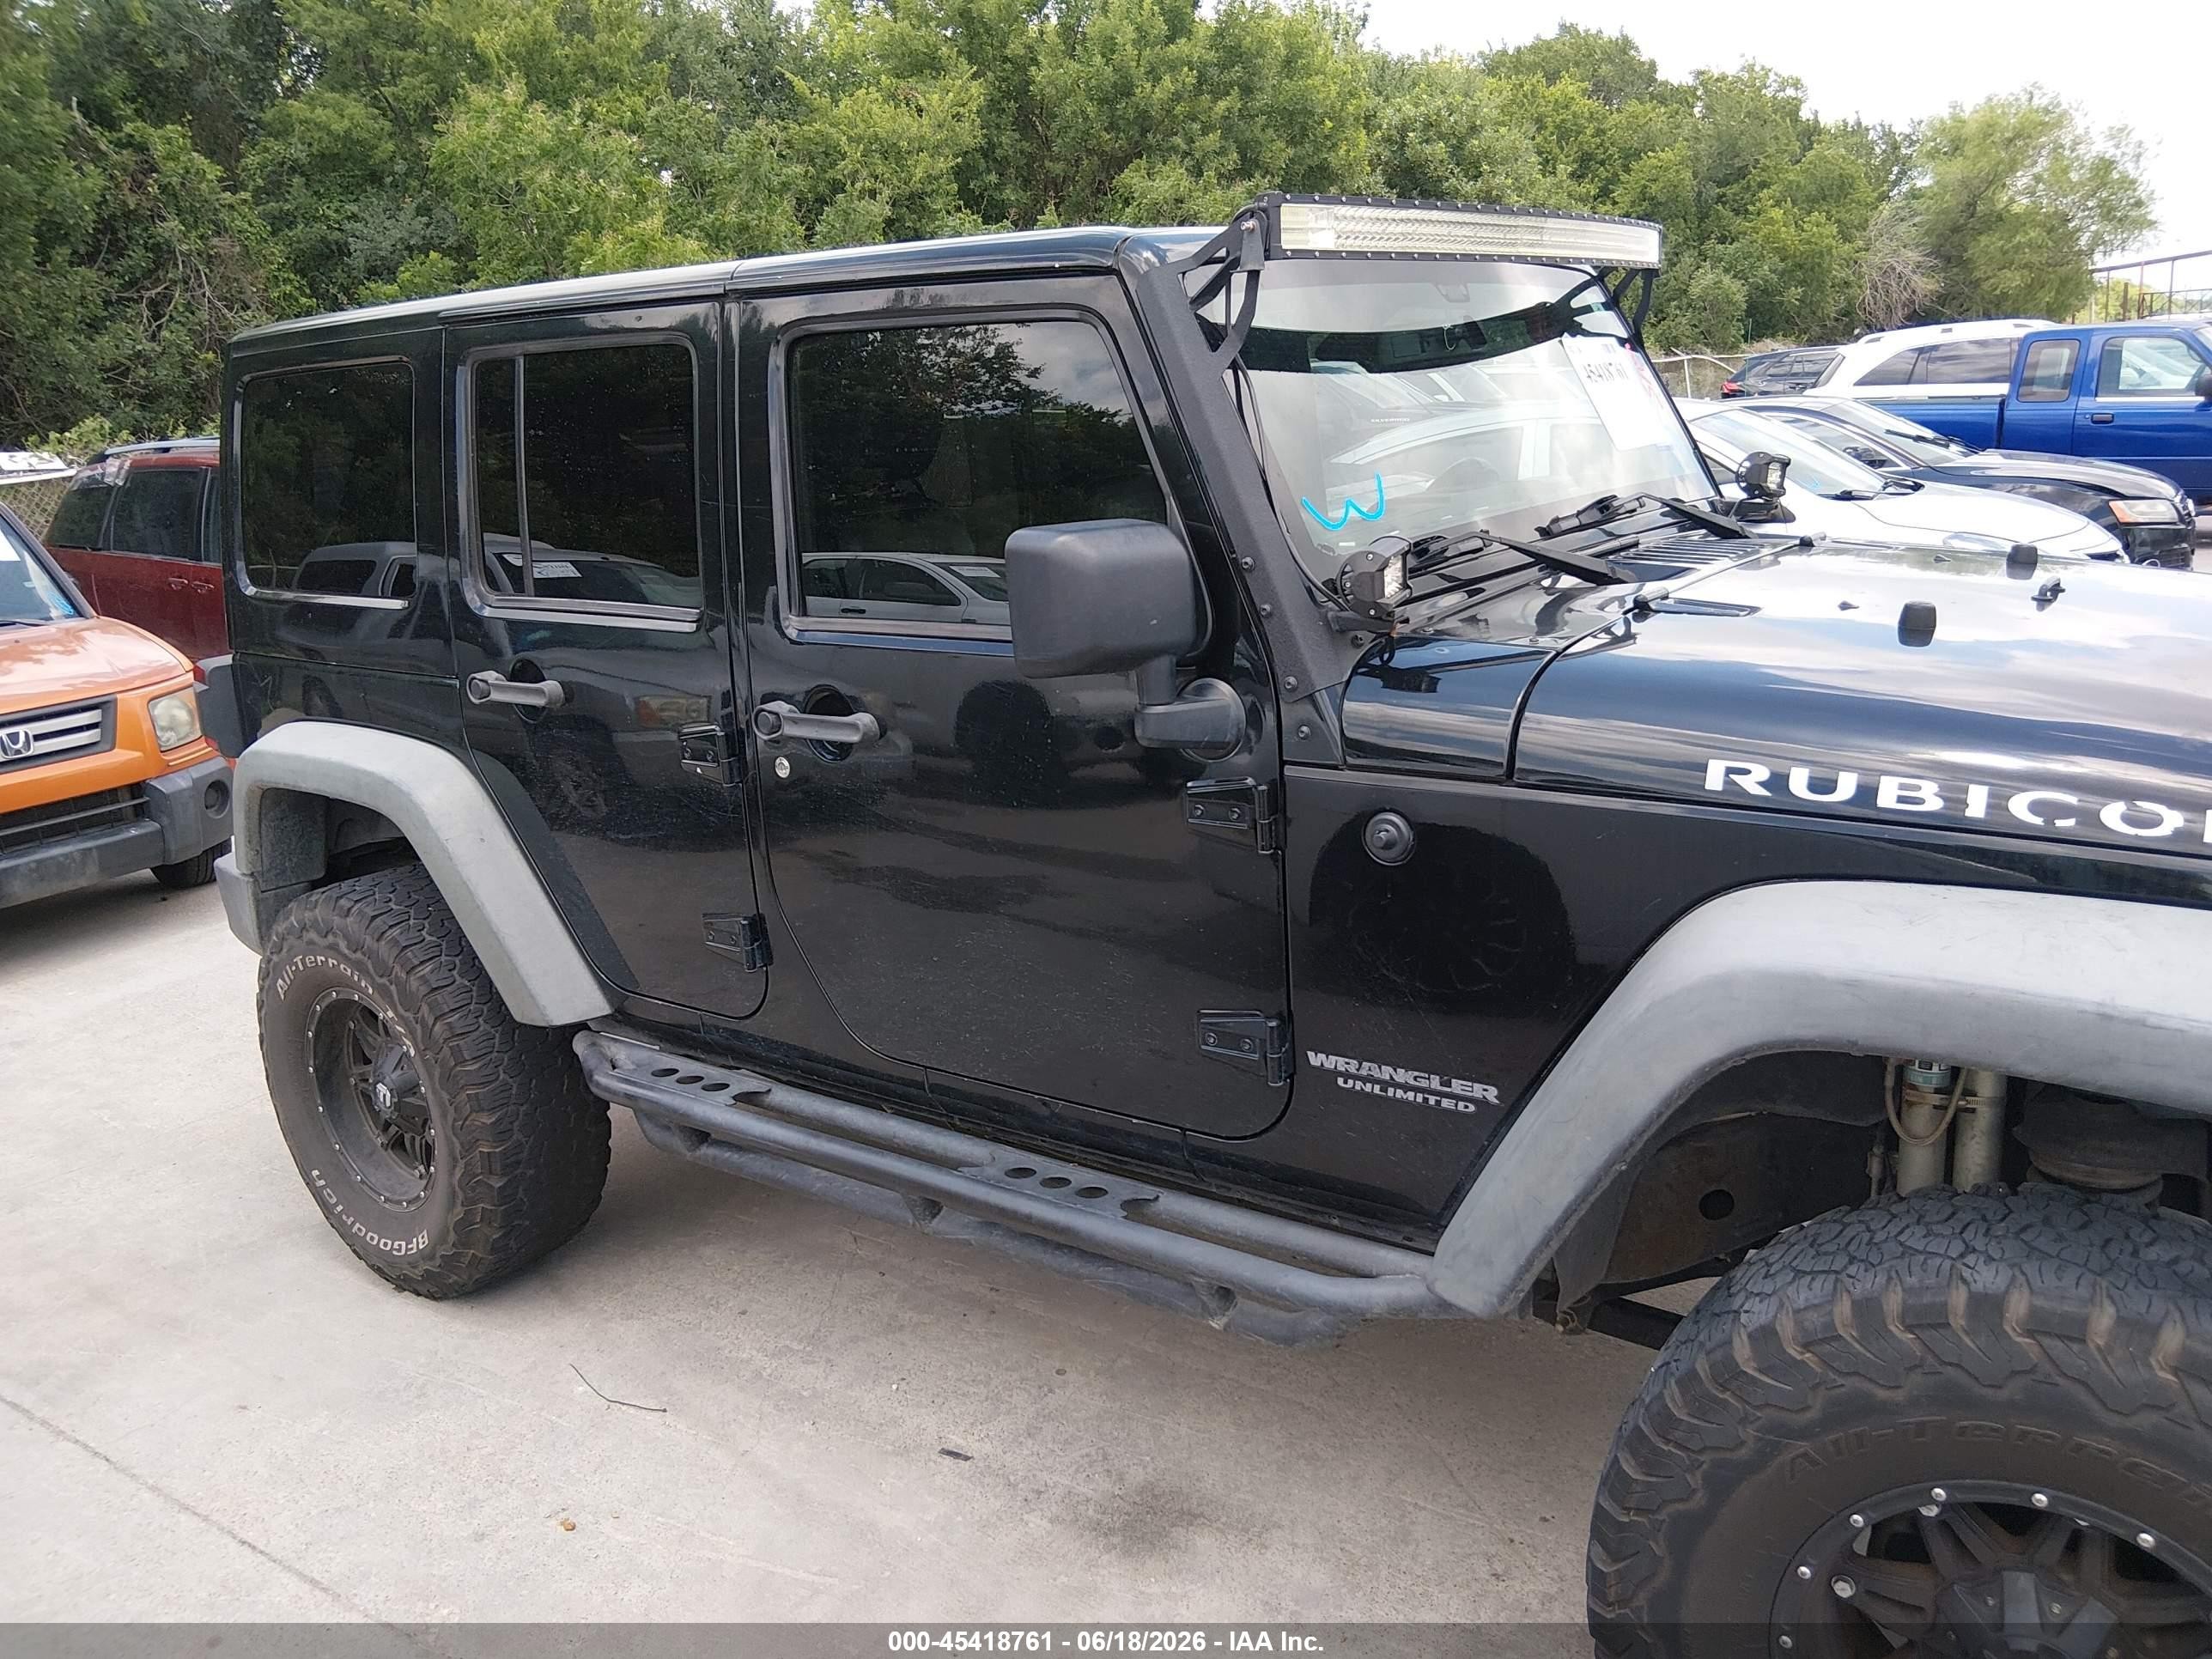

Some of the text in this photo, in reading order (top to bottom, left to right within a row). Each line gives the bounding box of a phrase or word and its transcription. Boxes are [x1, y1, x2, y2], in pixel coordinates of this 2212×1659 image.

[1704, 758, 2212, 843] RUBICO
[1306, 1050, 1502, 1105] WRANGLER
[1336, 1076, 1477, 1113] UNLIMITED
[311, 1169, 429, 1256] BFGoodrich
